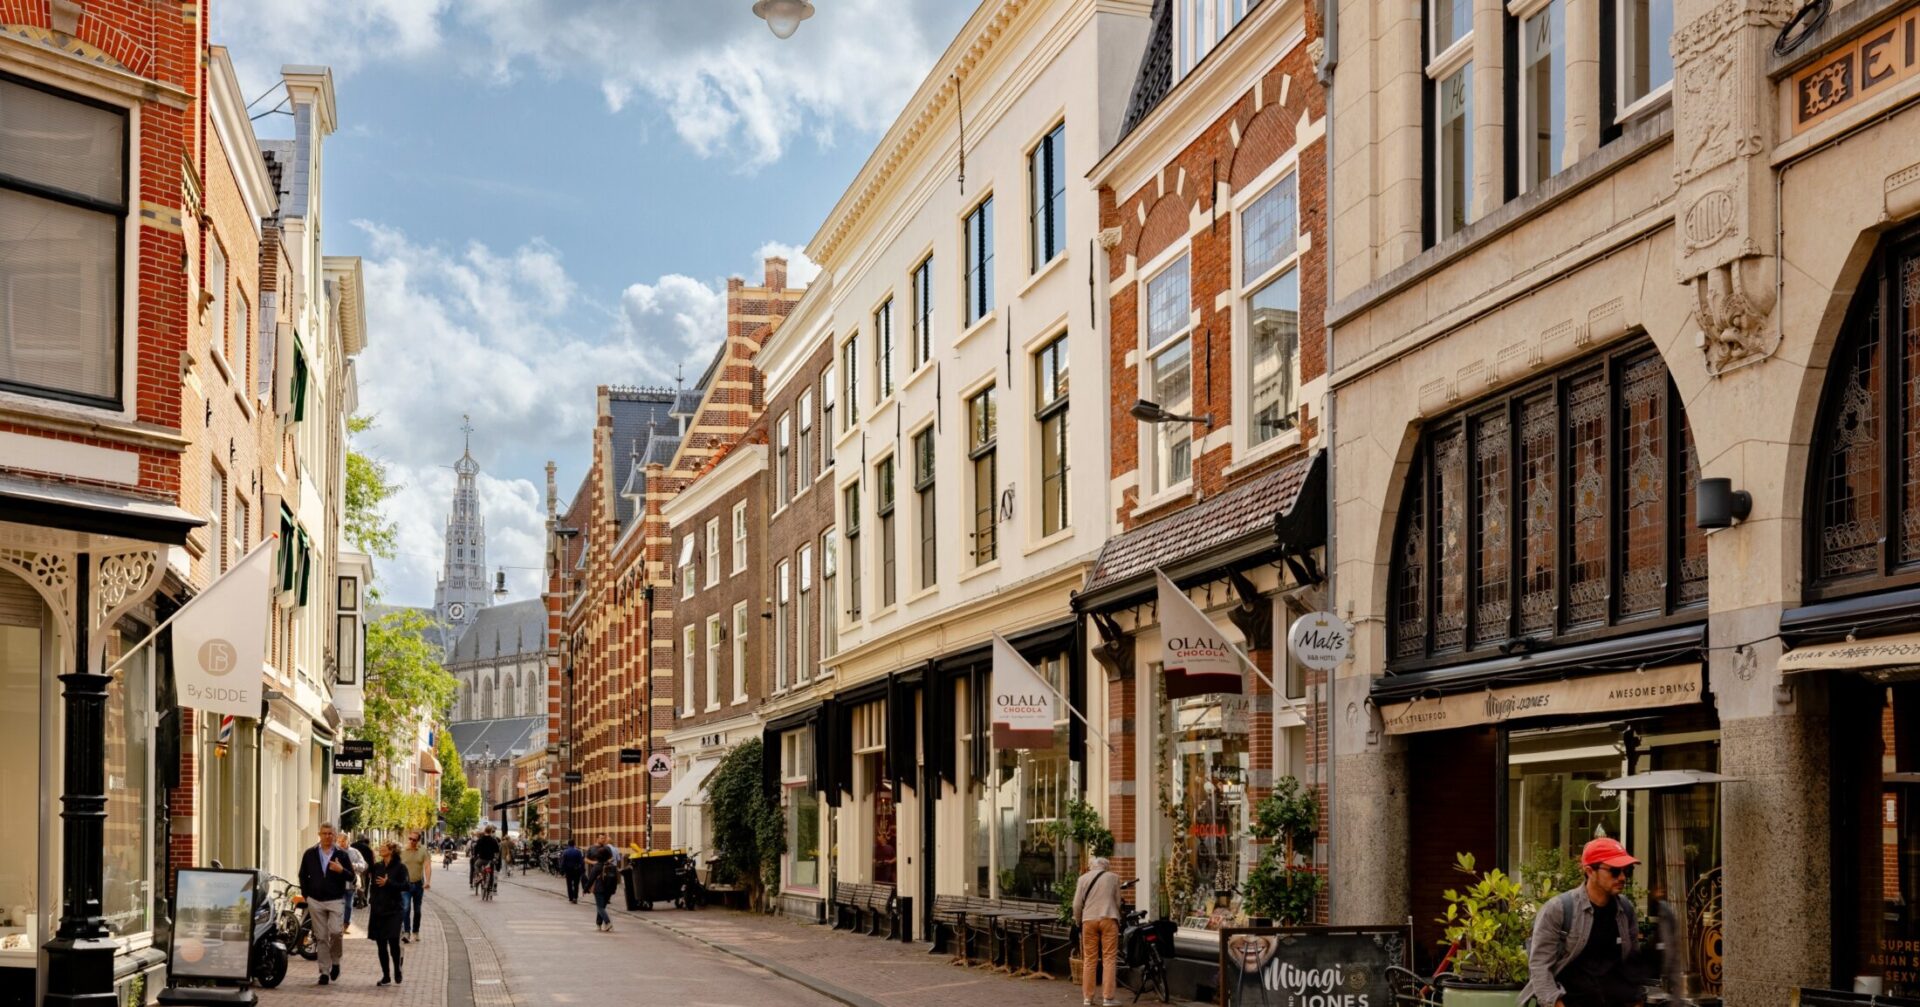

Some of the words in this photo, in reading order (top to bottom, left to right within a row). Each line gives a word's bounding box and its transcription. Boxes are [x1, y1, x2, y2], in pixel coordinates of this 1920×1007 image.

[1167, 637, 1229, 653] OLALA
[1299, 629, 1345, 651] Malts
[1176, 650, 1225, 658] CHOCOLA
[1785, 652, 1824, 662] ASIAN
[187, 683, 202, 699] By
[205, 688, 248, 703] SIDDE
[1608, 686, 1656, 699] AWESOME
[1659, 682, 1696, 695] DRINKS
[996, 694, 1047, 706] OLALA
[335, 759, 353, 767] kvik
[1869, 954, 1907, 966] ASIAN
[1264, 957, 1346, 996] Miyagi
[1885, 970, 1917, 982] SEXY
